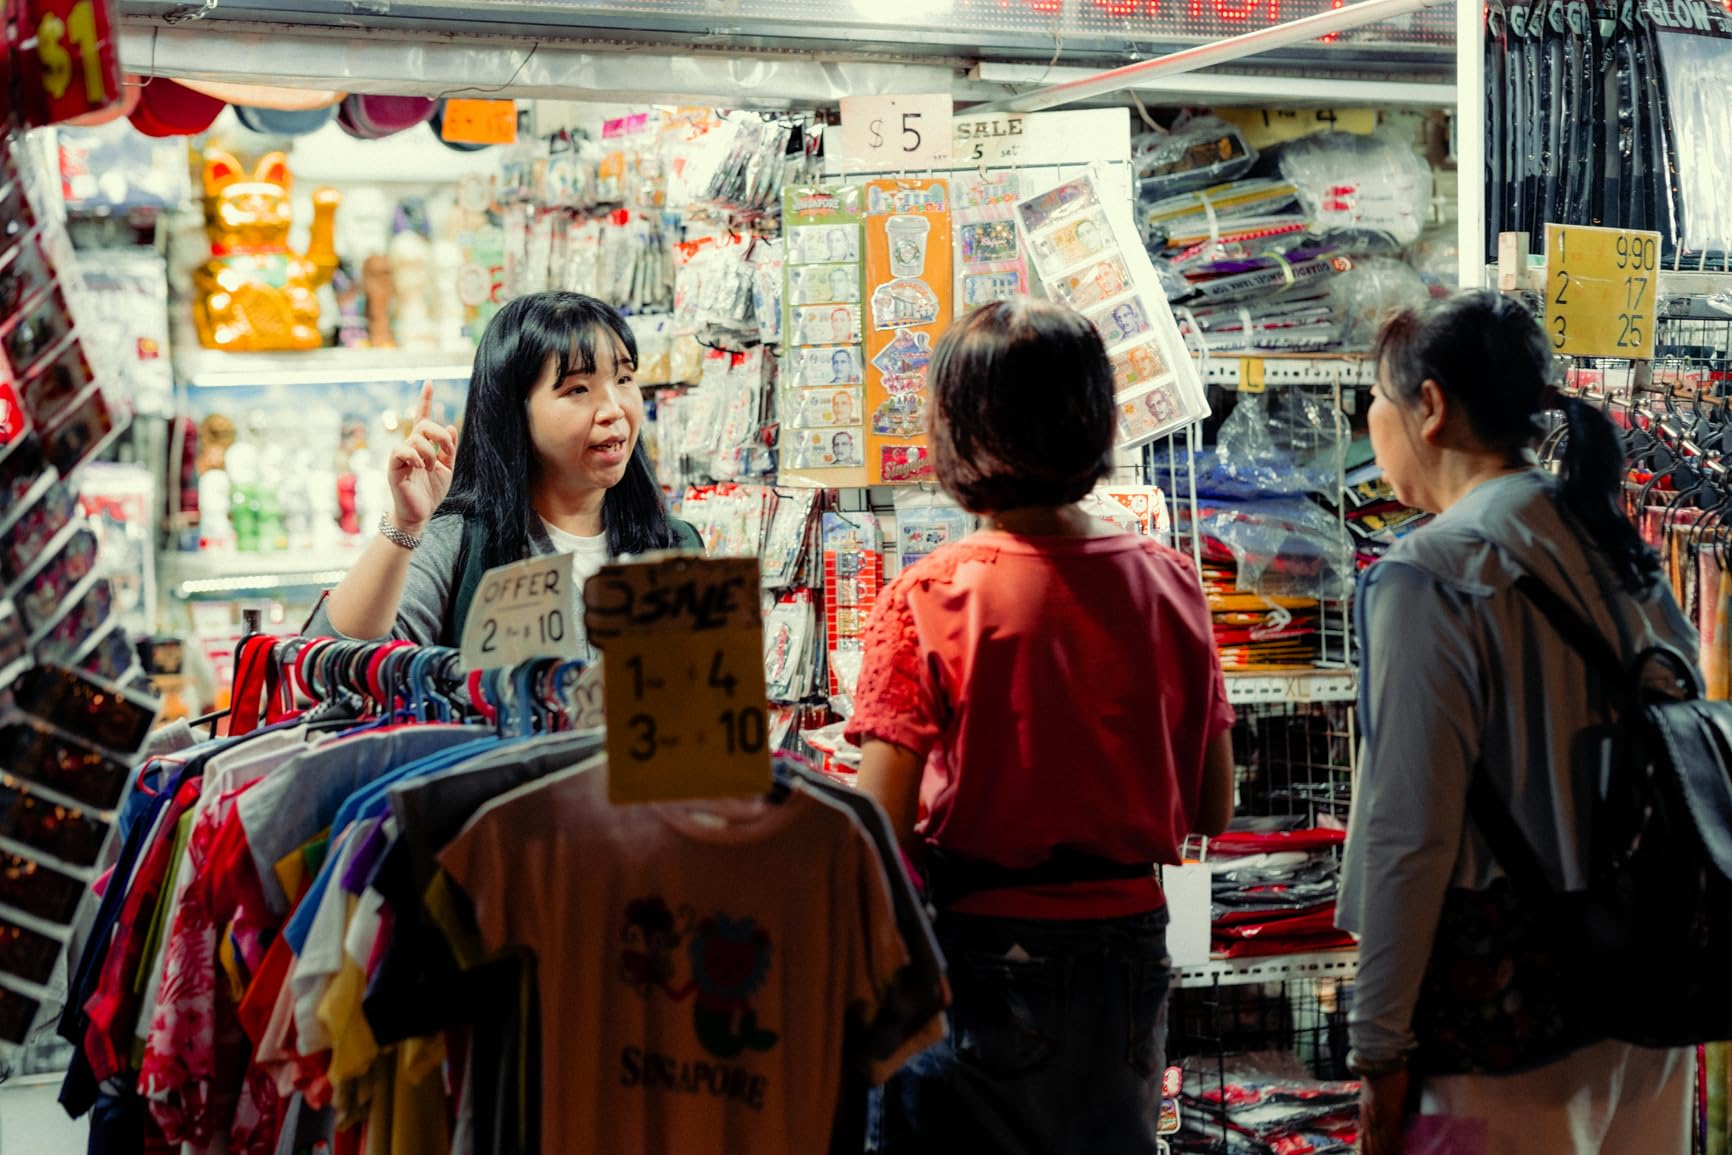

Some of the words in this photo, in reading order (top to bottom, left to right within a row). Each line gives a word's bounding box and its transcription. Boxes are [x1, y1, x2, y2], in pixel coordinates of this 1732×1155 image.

[1648, 0, 1711, 31] GLOW
[902, 113, 922, 153] 5
[956, 118, 1023, 139] SALE
[971, 143, 984, 160] 5
[1555, 270, 1569, 305] 2
[1624, 276, 1648, 310] 17
[1553, 315, 1567, 349] 3
[1616, 313, 1643, 347] 25
[483, 569, 560, 603] OFFER
[481, 619, 498, 652] 2
[539, 609, 564, 644] 10
[627, 655, 644, 701] 1
[708, 650, 738, 696] 4
[628, 714, 657, 762] 3
[719, 706, 766, 754] 10
